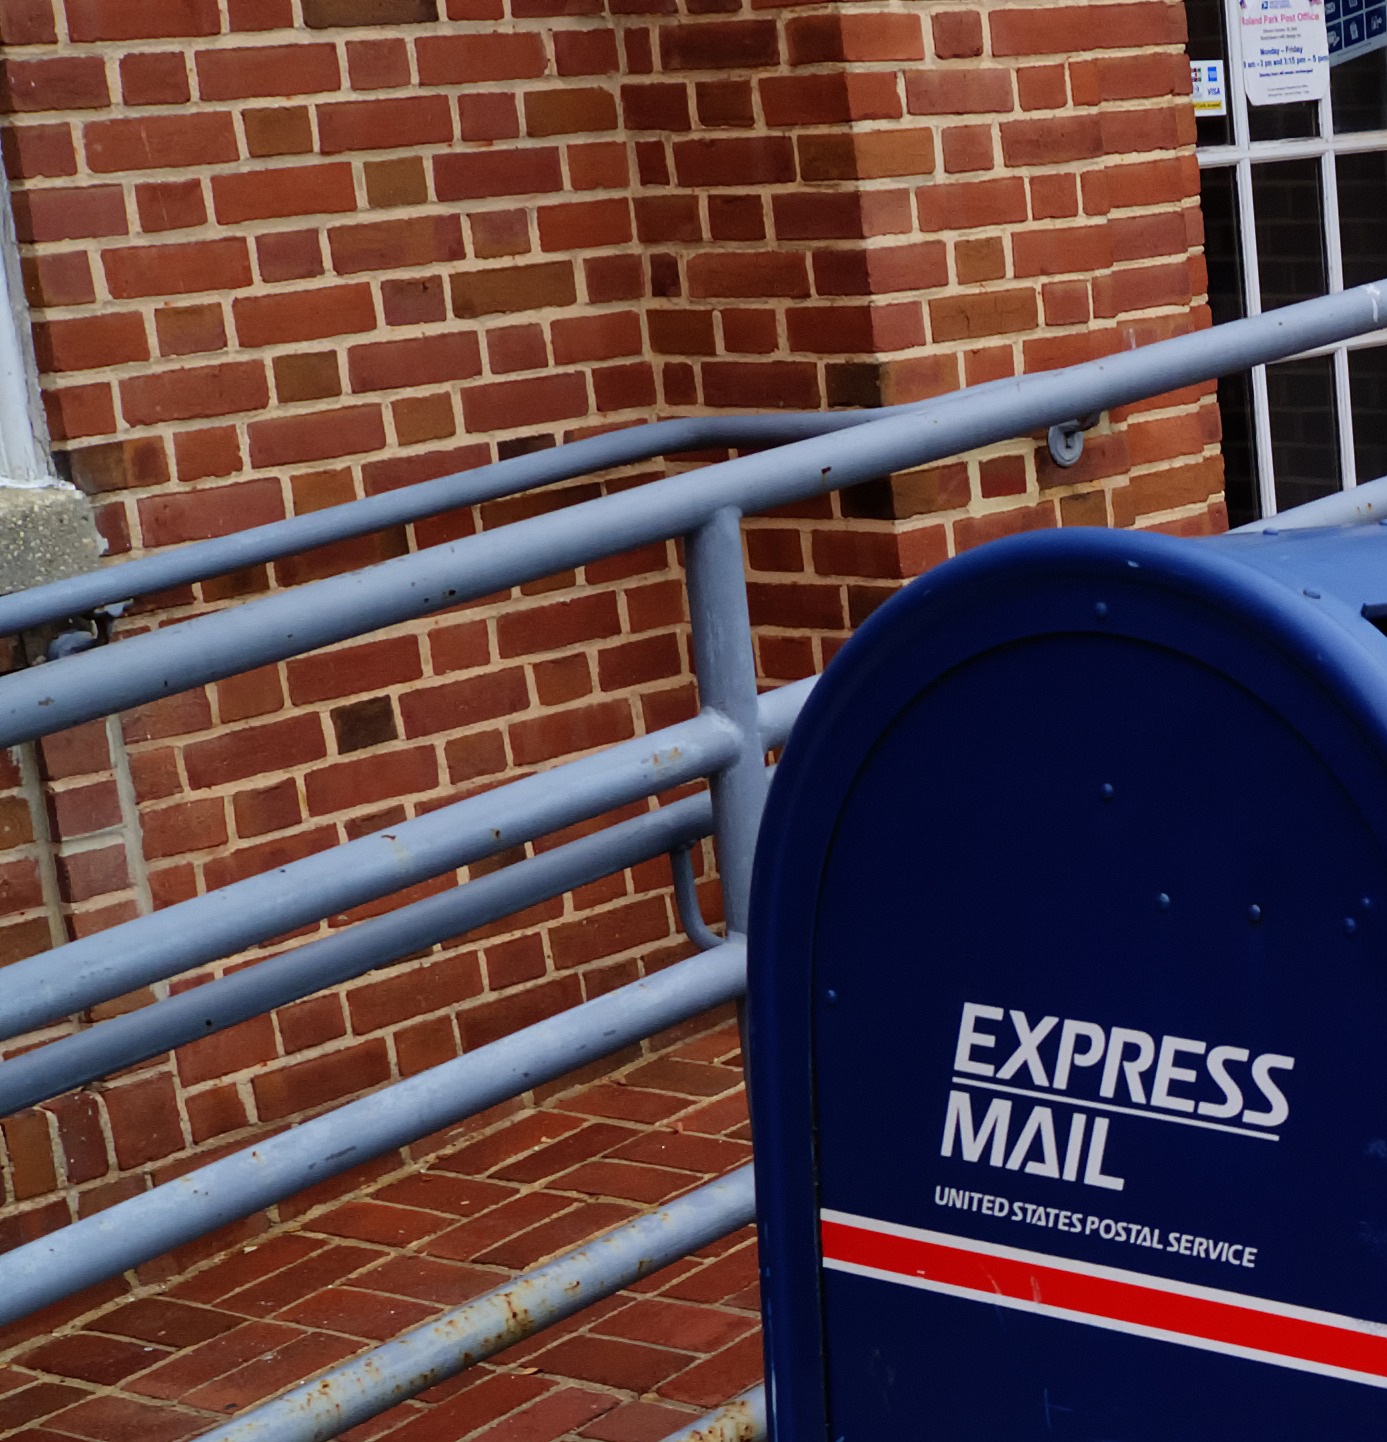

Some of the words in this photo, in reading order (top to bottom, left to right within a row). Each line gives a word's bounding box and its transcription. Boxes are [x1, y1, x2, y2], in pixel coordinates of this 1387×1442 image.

[1264, 15, 1278, 24] Park
[1281, 14, 1296, 22] Post
[1297, 12, 1319, 21] Office
[1285, 46, 1303, 54] Friday
[1207, 87, 1220, 95] VISA
[953, 1002, 1295, 1127] EXPRESS
[940, 1090, 1124, 1191] MAIL
[934, 1185, 1009, 1217] UNITED
[1011, 1201, 1083, 1234] STATES
[1085, 1216, 1164, 1250] POSTAL
[1166, 1232, 1258, 1268] SERVICE
